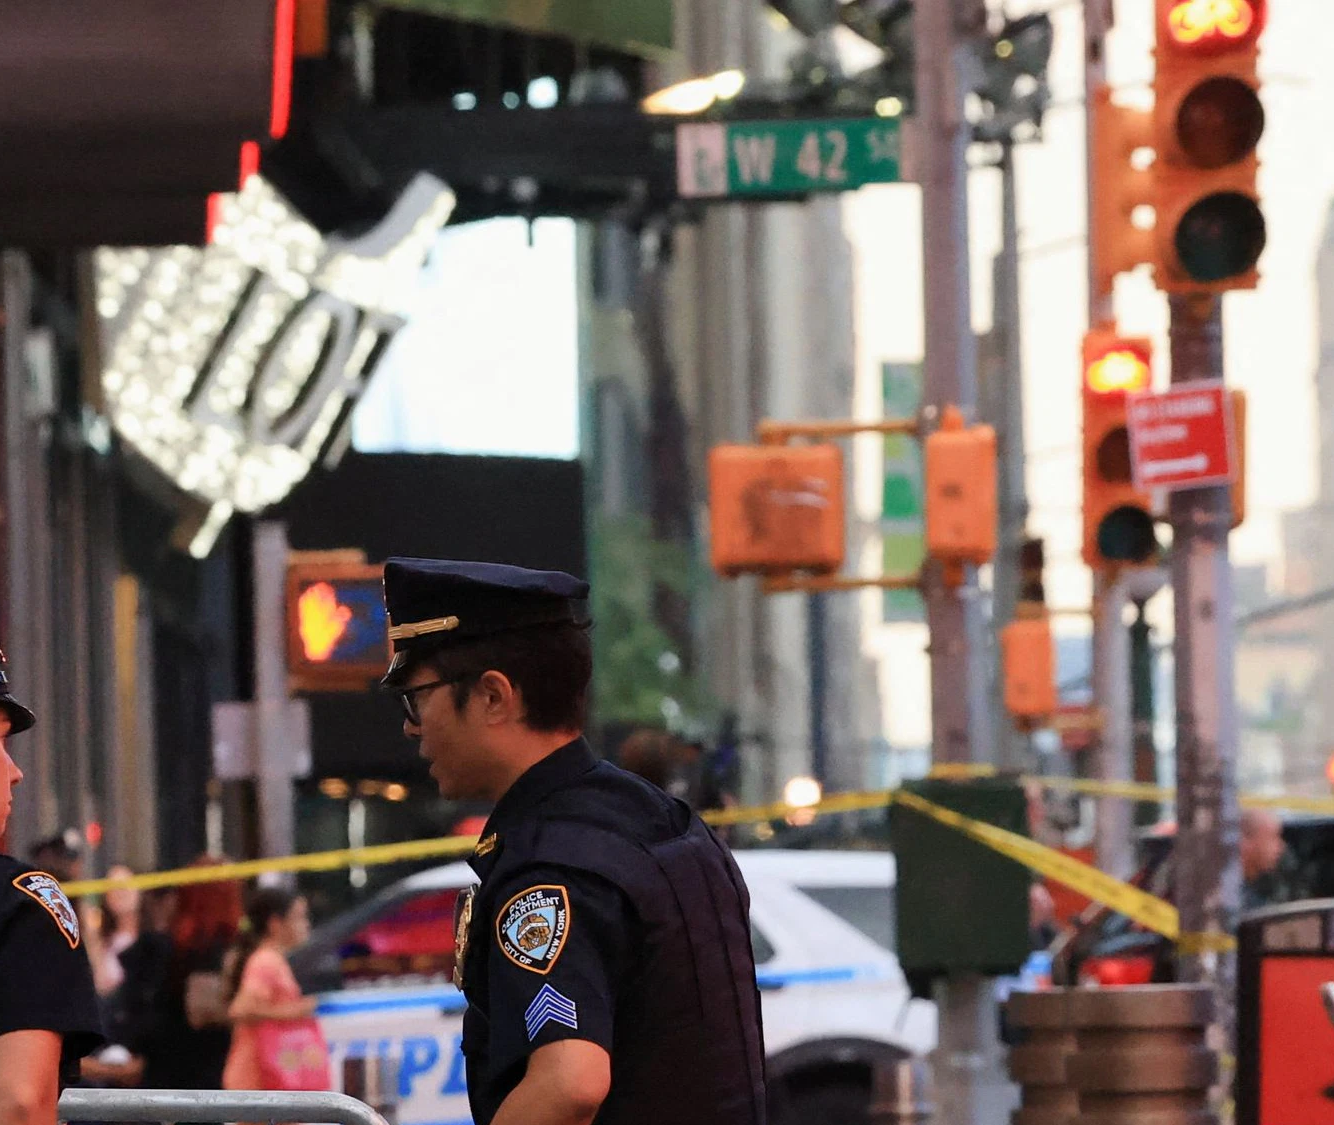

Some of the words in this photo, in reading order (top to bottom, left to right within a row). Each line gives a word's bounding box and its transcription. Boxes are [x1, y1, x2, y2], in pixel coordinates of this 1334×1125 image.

[731, 131, 777, 186] W
[795, 127, 850, 184] 42
[501, 896, 559, 934] DEPARTMENT
[509, 890, 543, 914] POLICE
[504, 941, 521, 958] CITY
[519, 955, 533, 965] OF
[546, 937, 560, 960] NEW
[555, 909, 566, 938] YORK
